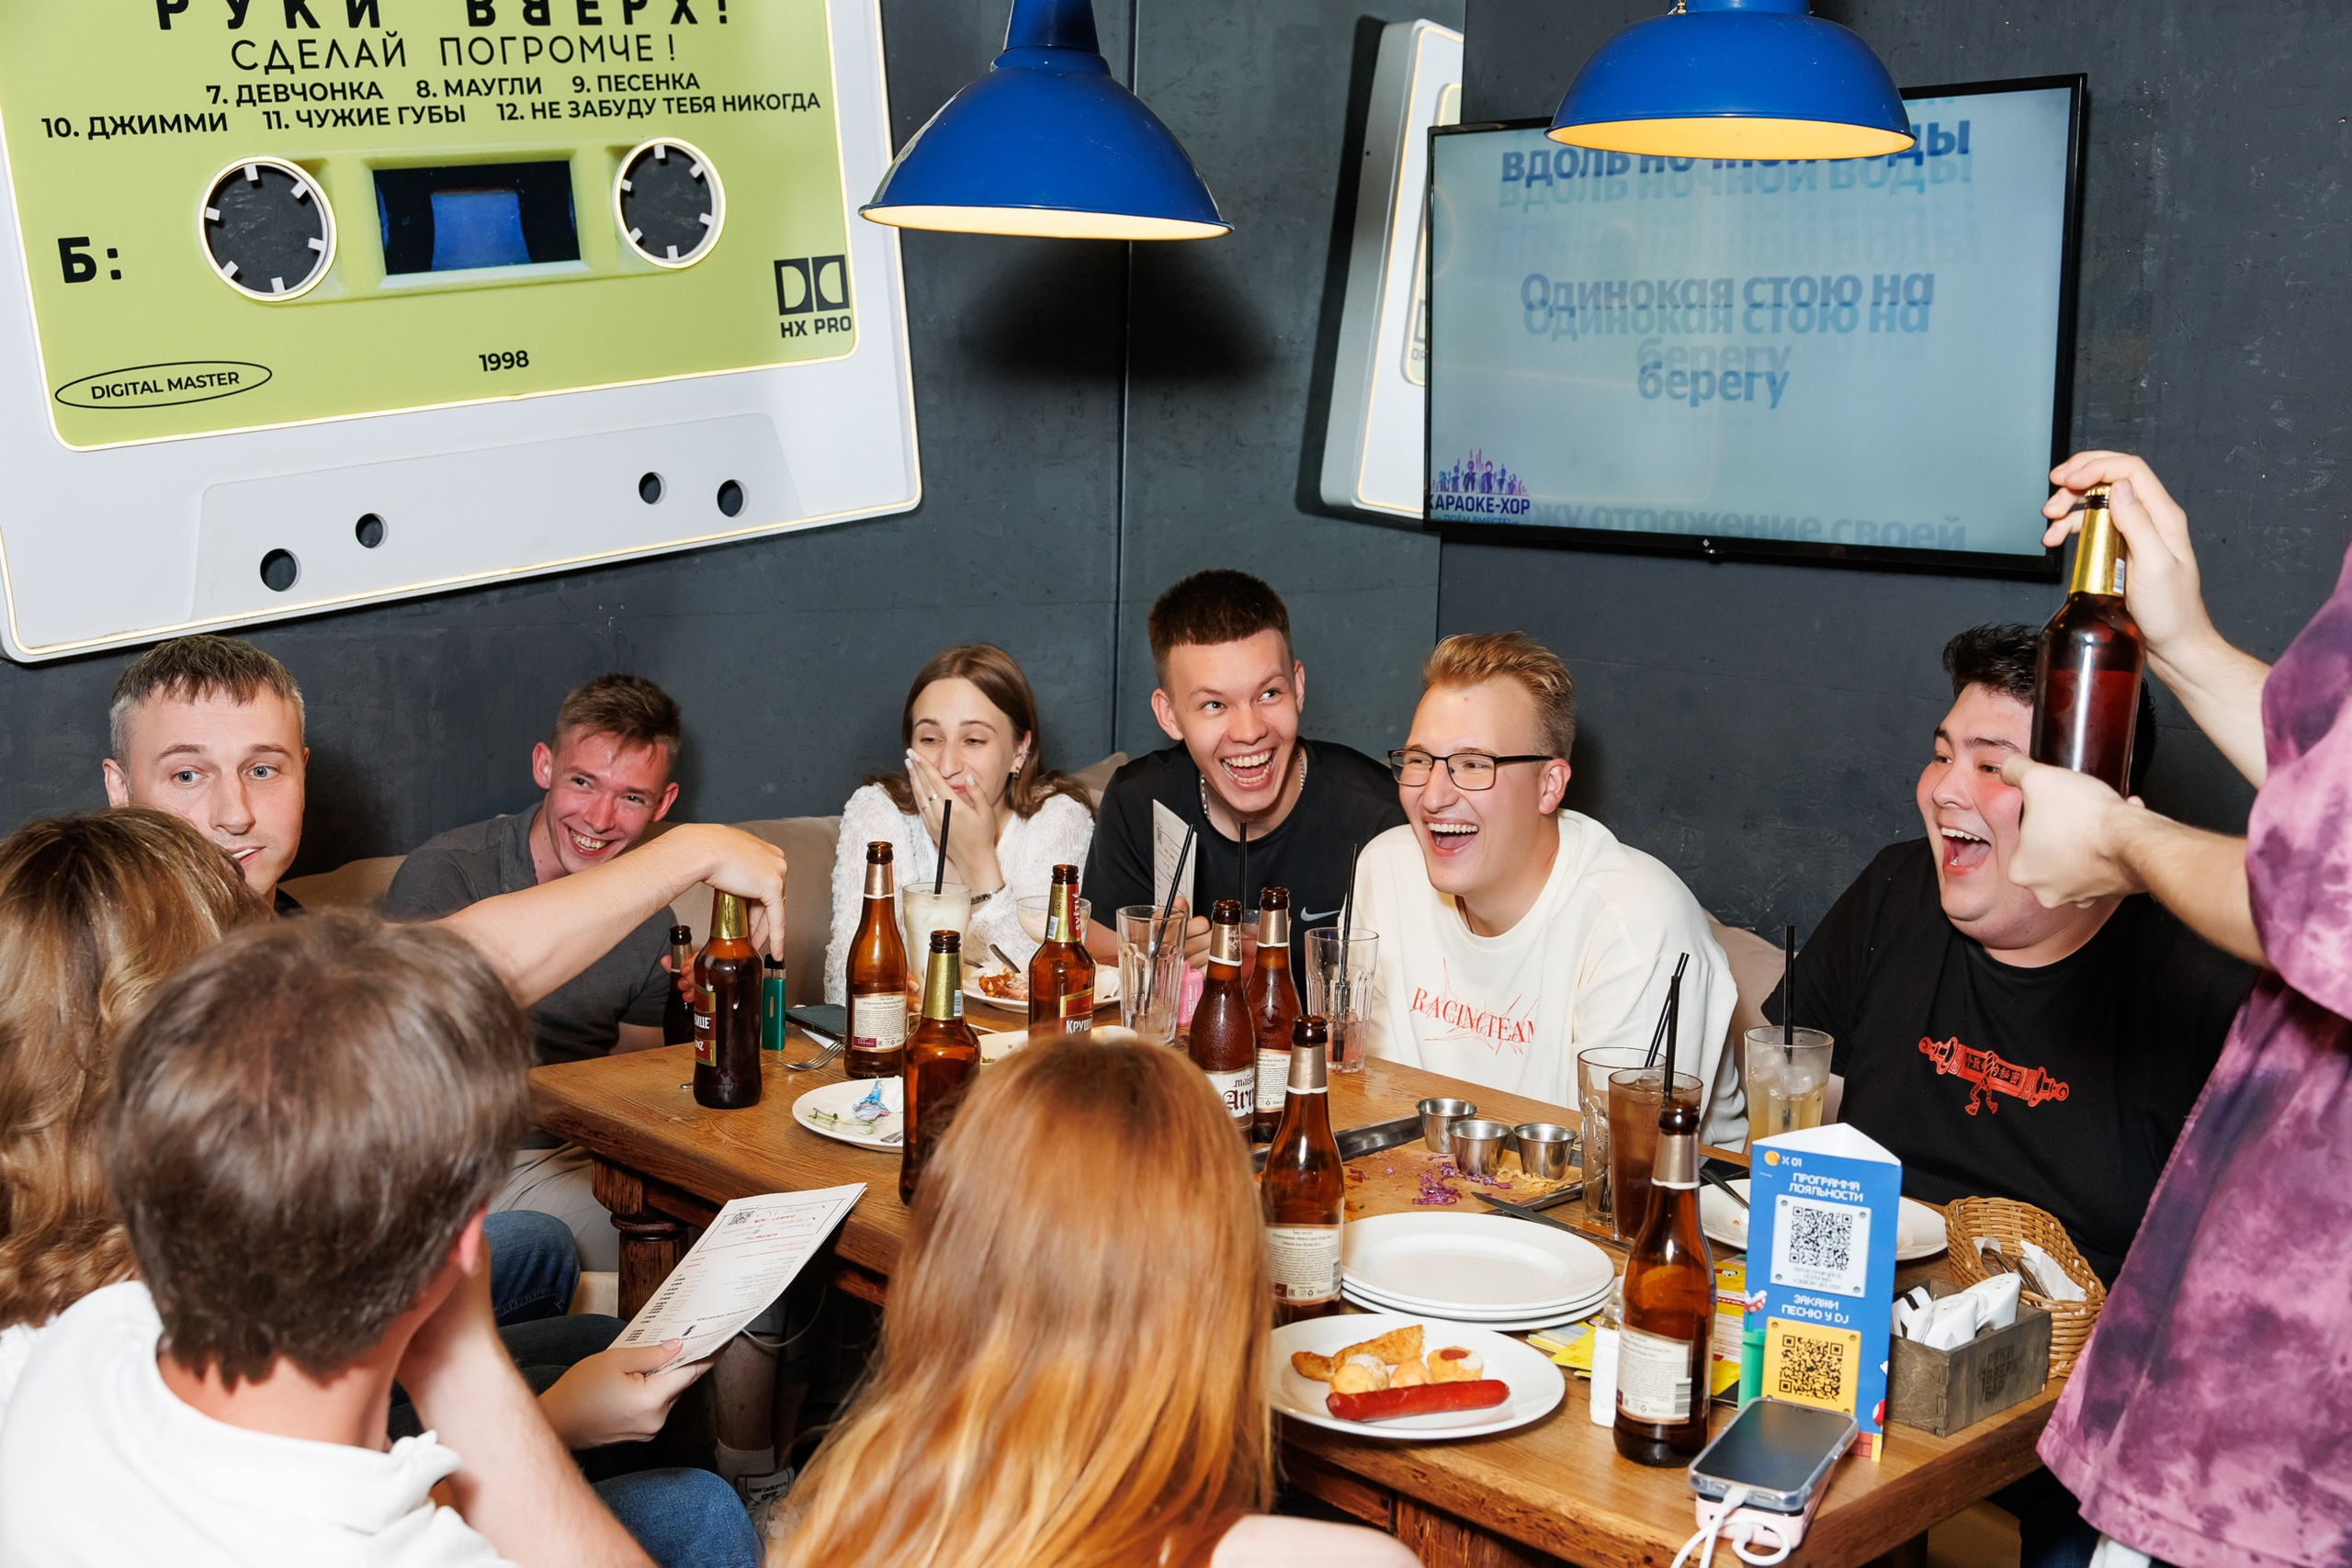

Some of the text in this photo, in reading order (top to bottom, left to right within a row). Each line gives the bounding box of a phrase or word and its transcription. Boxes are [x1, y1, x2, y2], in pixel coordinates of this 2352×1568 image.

[232, 31, 405, 74] СДЕЛАЙ
[206, 73, 700, 107] 7. ДЕВЧОНКА 8. МАУГЛИ 9. ПЕСЕНКА
[41, 93, 820, 140] 10. ДЖИММИ 11. ЧУЖИЕ ГУБЫ 12. НЕ ЗАБУДУ ТЕБЯ НИКОГДА
[58, 237, 121, 283] Б:
[1521, 274, 1735, 340] Одинокая
[781, 316, 851, 338] HX PRO
[479, 350, 529, 371] 1998
[91, 371, 240, 400] DIGITAL MASTER
[1636, 338, 1791, 410] берегу
[1791, 1156, 1803, 1168] 01
[1788, 1182, 1864, 1203] ЛОЯЛЬНОСТИ
[1792, 1172, 1860, 1191] ПРОГРАММА
[1781, 1303, 1849, 1325] ПЕСНЮ У DJ
[1792, 1293, 1839, 1310] ЗАКАЖИ
